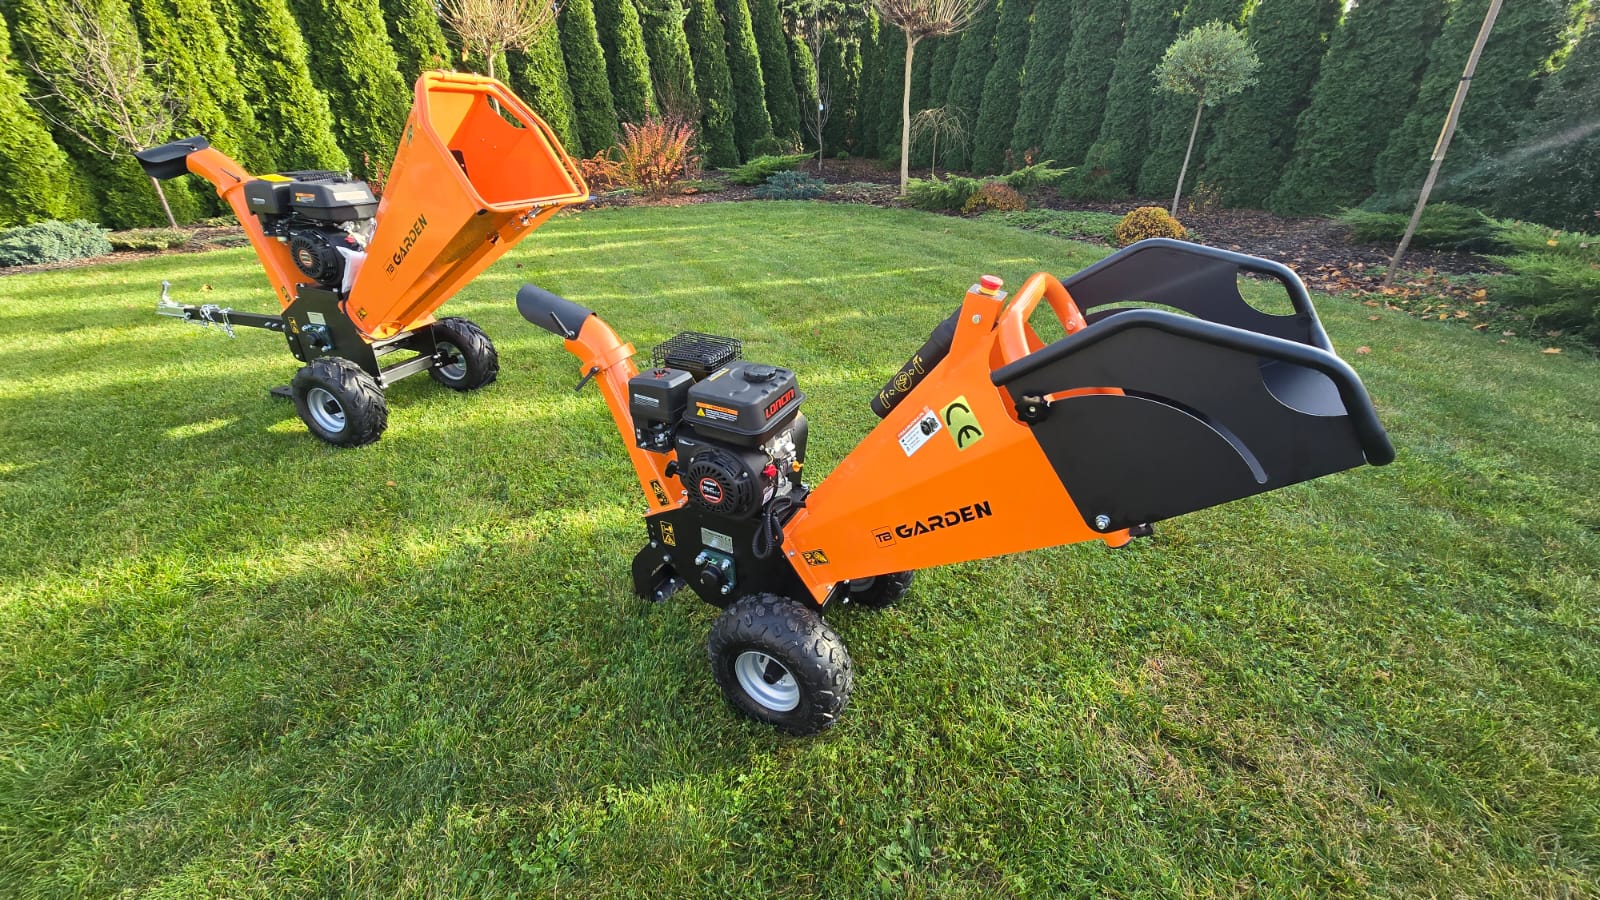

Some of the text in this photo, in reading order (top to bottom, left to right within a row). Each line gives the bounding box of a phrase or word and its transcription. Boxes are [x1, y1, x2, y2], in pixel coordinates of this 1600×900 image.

[393, 213, 428, 266] GARDEN
[765, 388, 795, 419] LONCIN
[946, 403, 982, 448] CE
[895, 500, 993, 538] GARDEN
